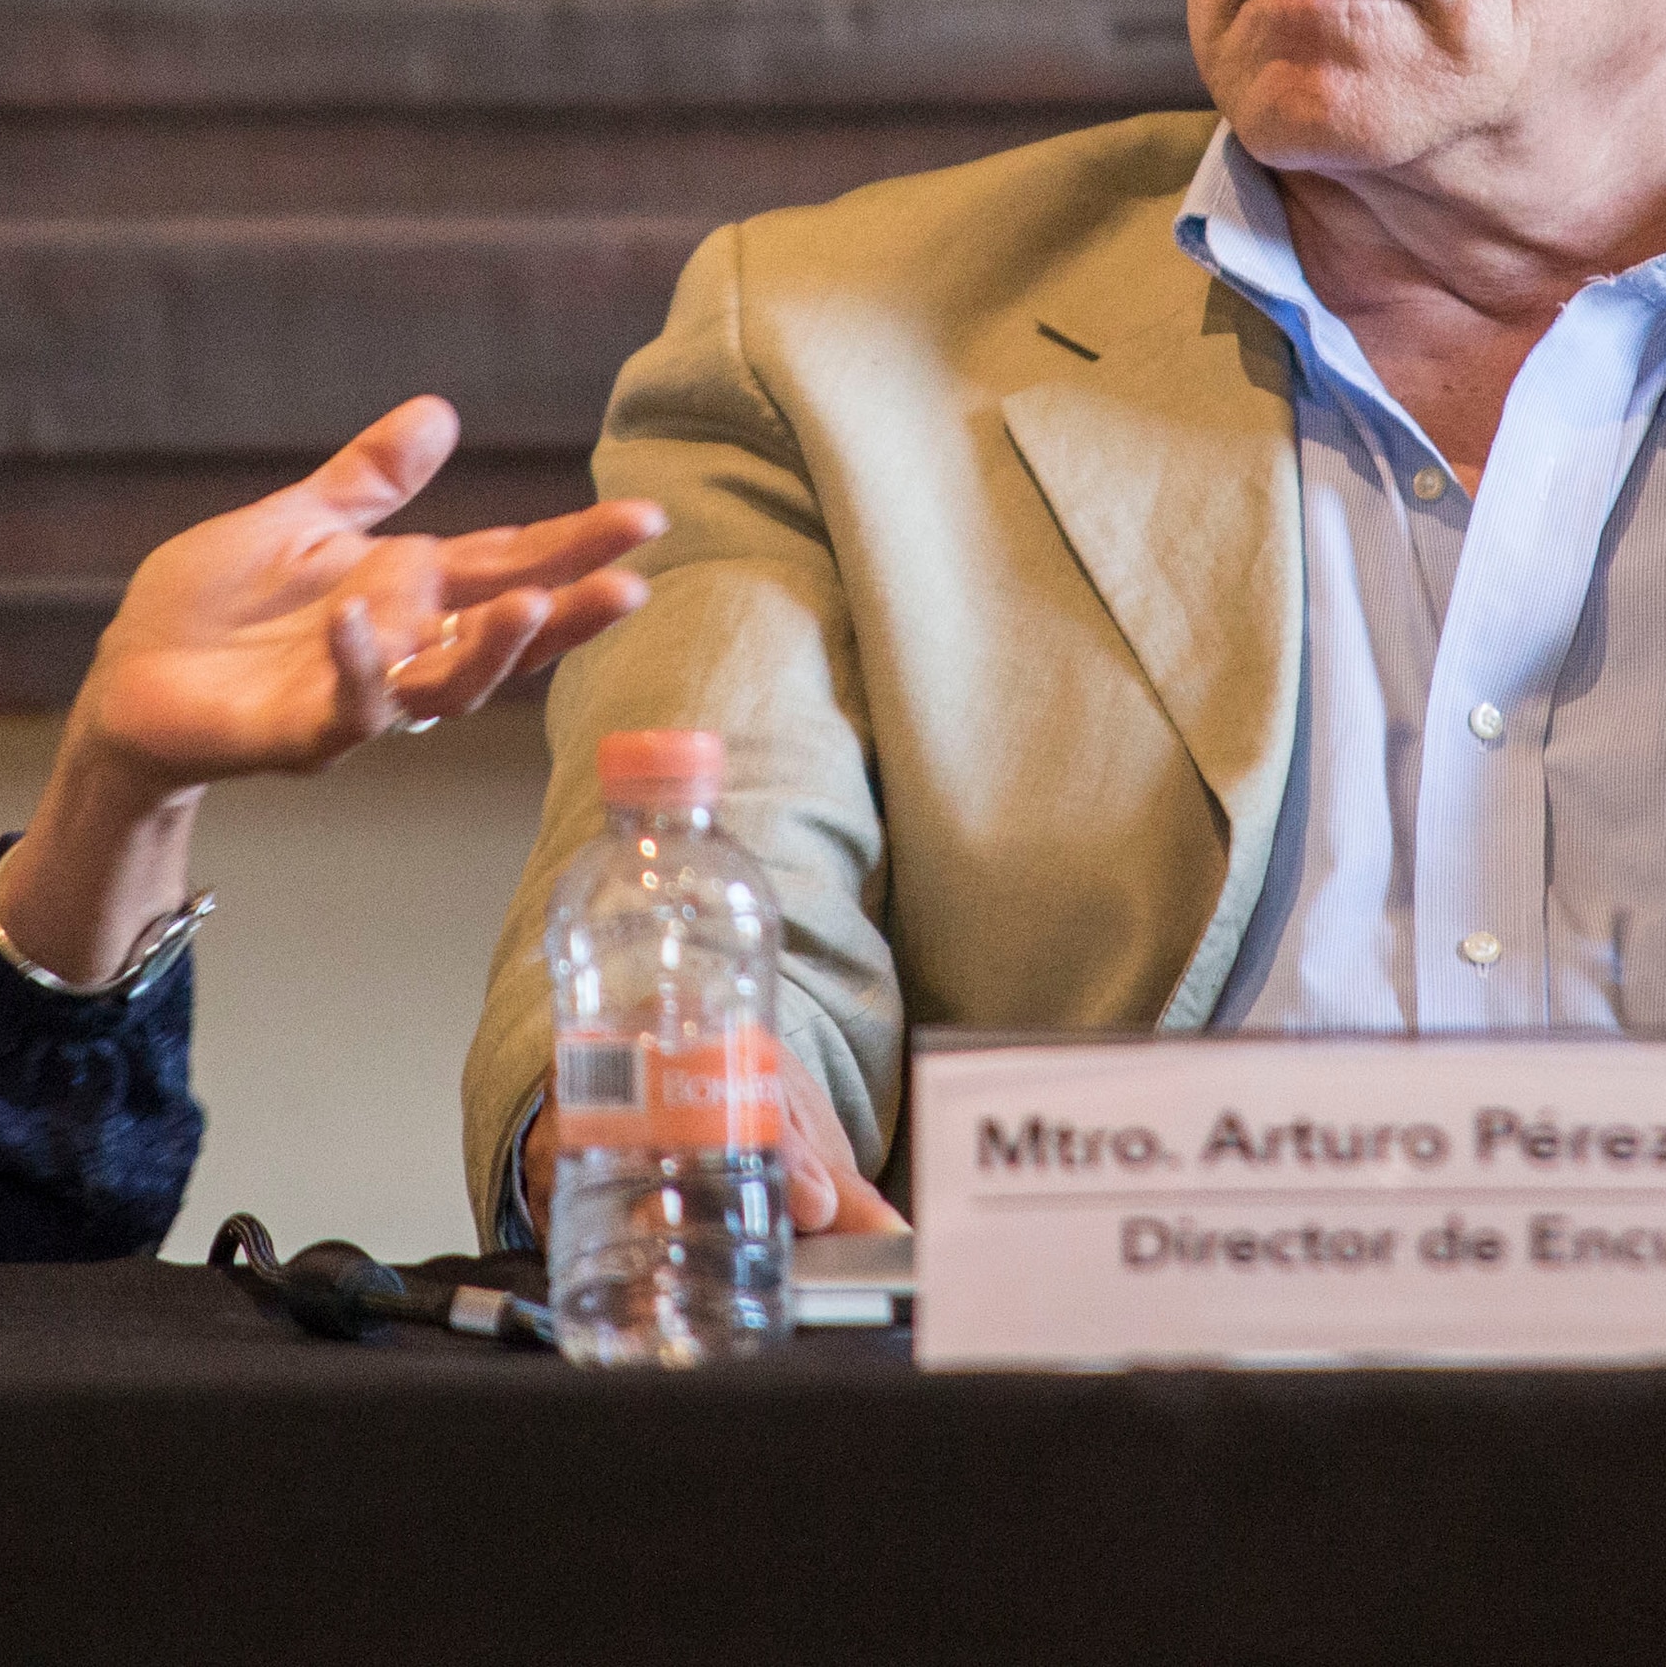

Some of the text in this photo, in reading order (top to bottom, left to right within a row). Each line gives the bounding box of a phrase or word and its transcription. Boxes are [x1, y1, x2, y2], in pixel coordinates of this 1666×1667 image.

[976, 1113, 1181, 1172] Mtro.
[1199, 1108, 1451, 1172] Arturo
[1120, 1215, 1394, 1272] Director
[1420, 1213, 1505, 1271] de
